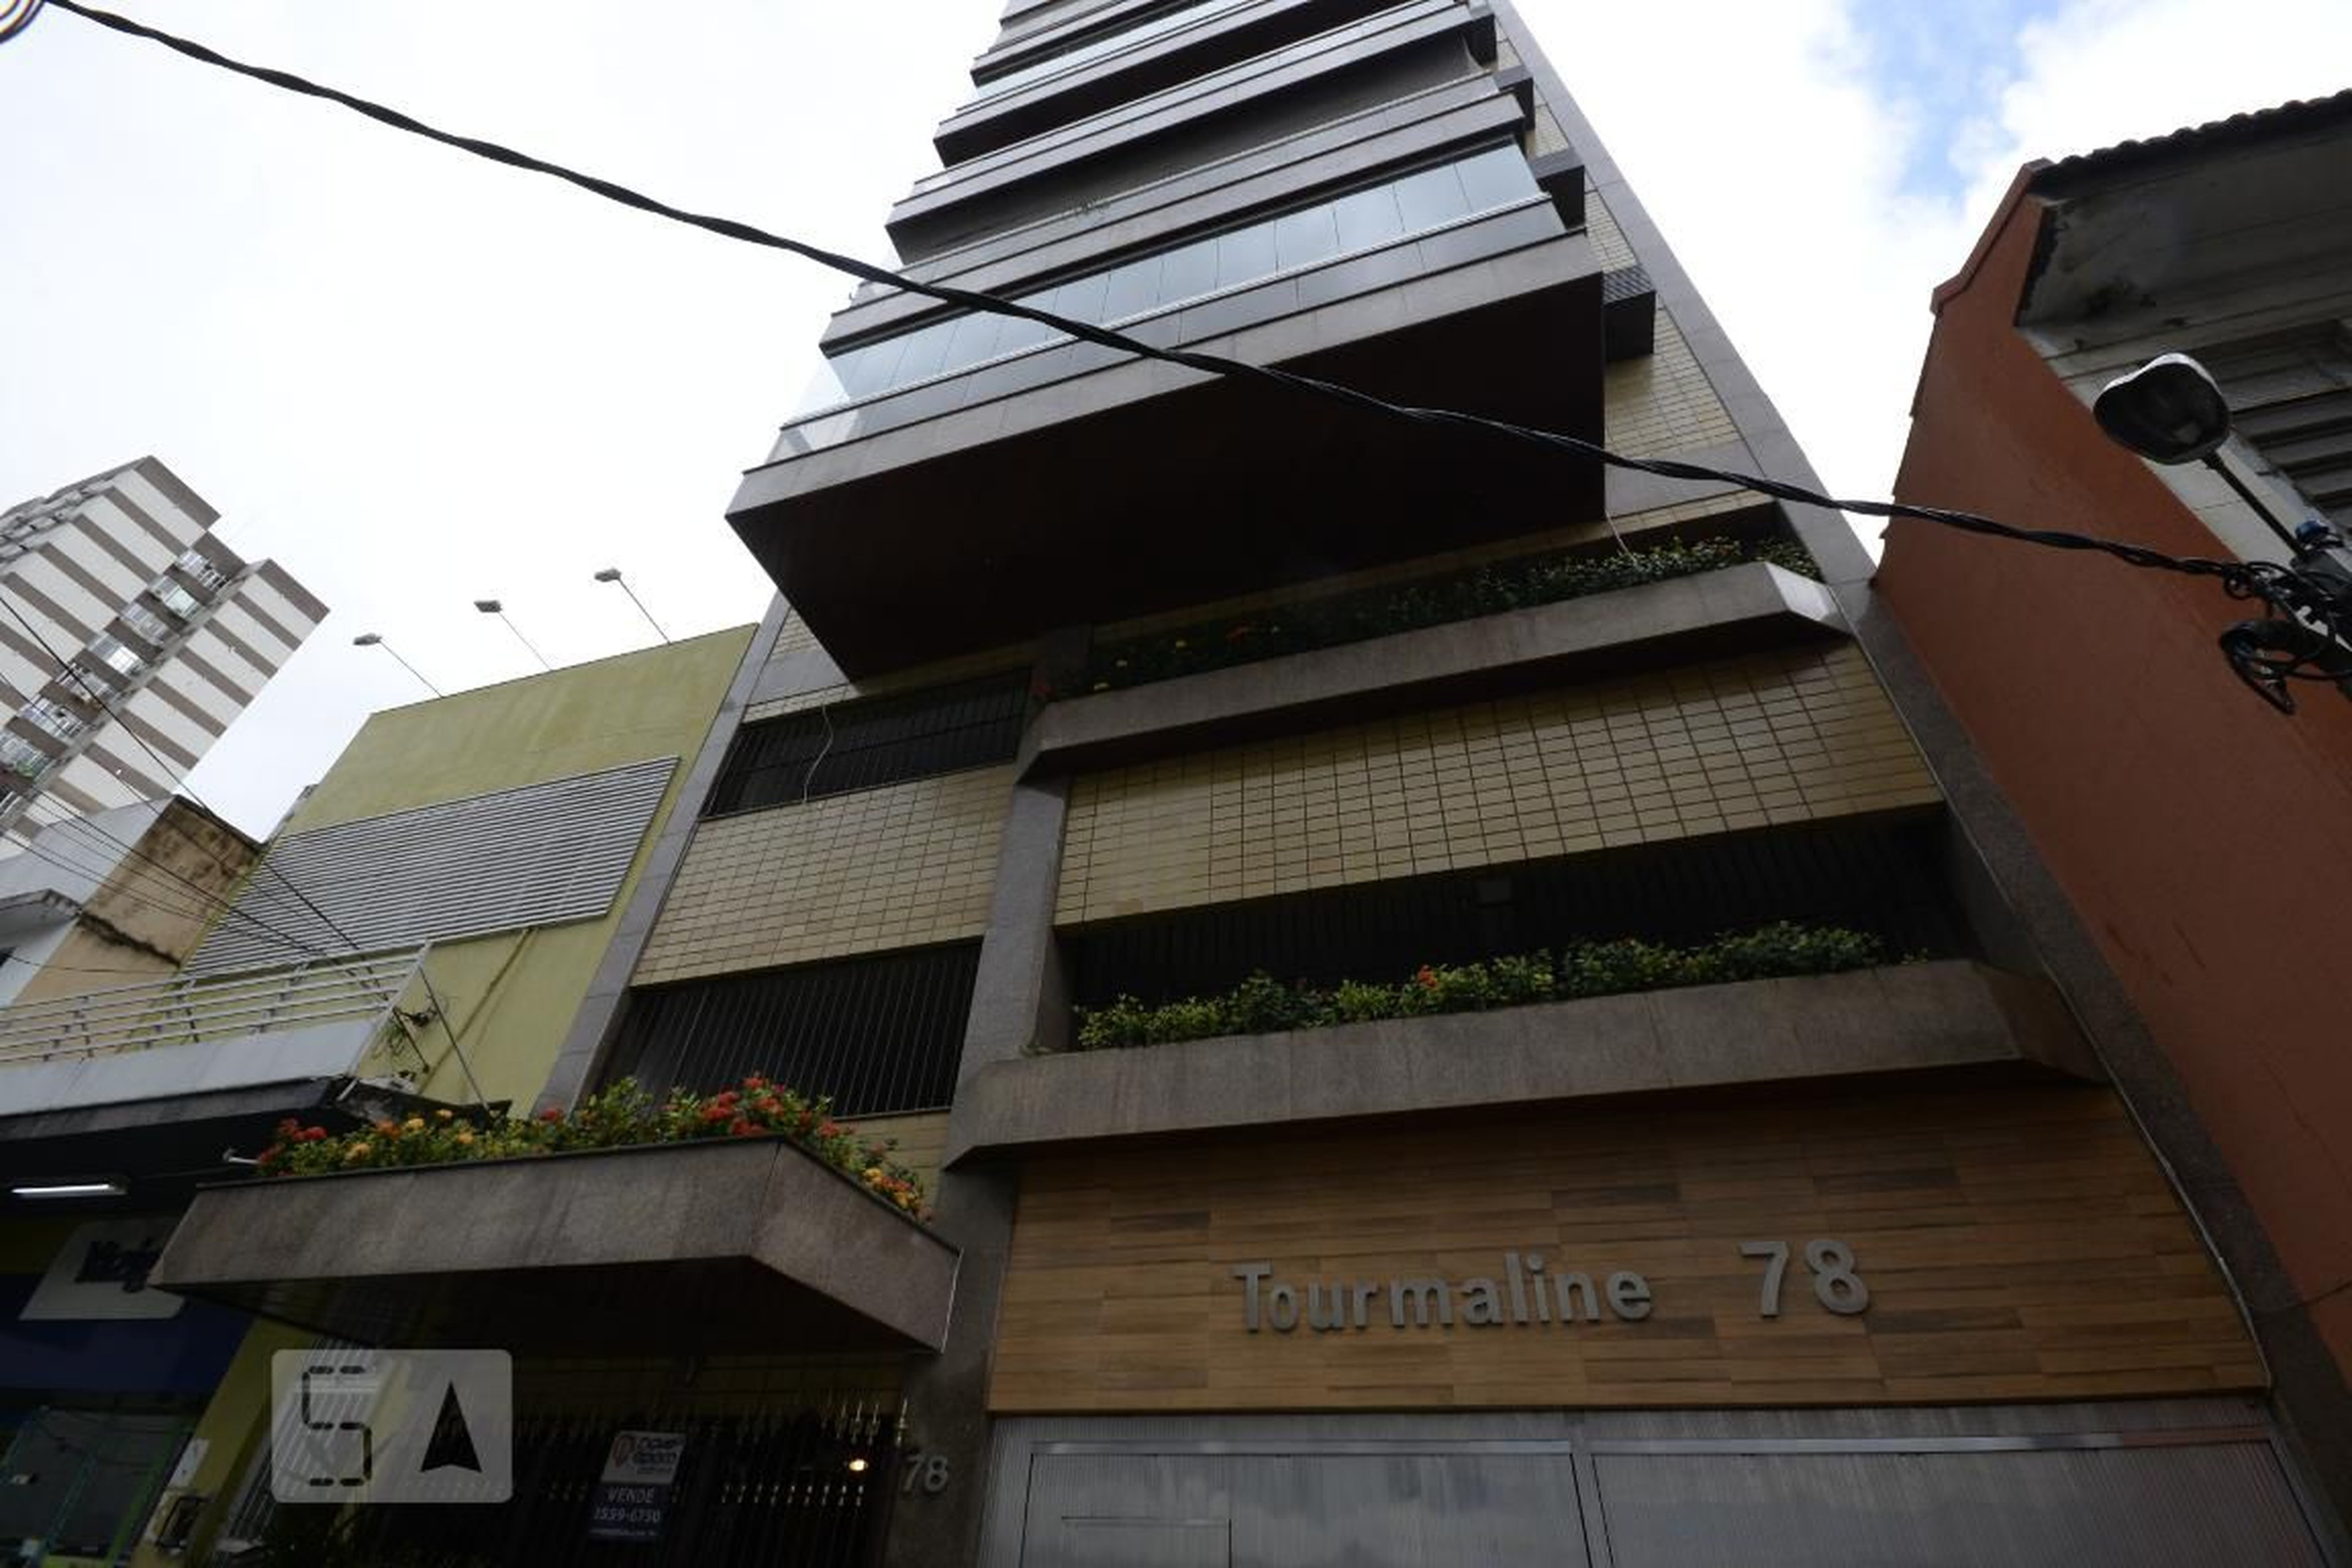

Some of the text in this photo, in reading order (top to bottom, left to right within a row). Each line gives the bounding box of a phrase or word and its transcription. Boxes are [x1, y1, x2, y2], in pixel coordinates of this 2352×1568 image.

[1232, 1238, 1869, 1331] Tourmaline 78
[903, 1454, 949, 1493] 78
[606, 1486, 655, 1504] VENDE
